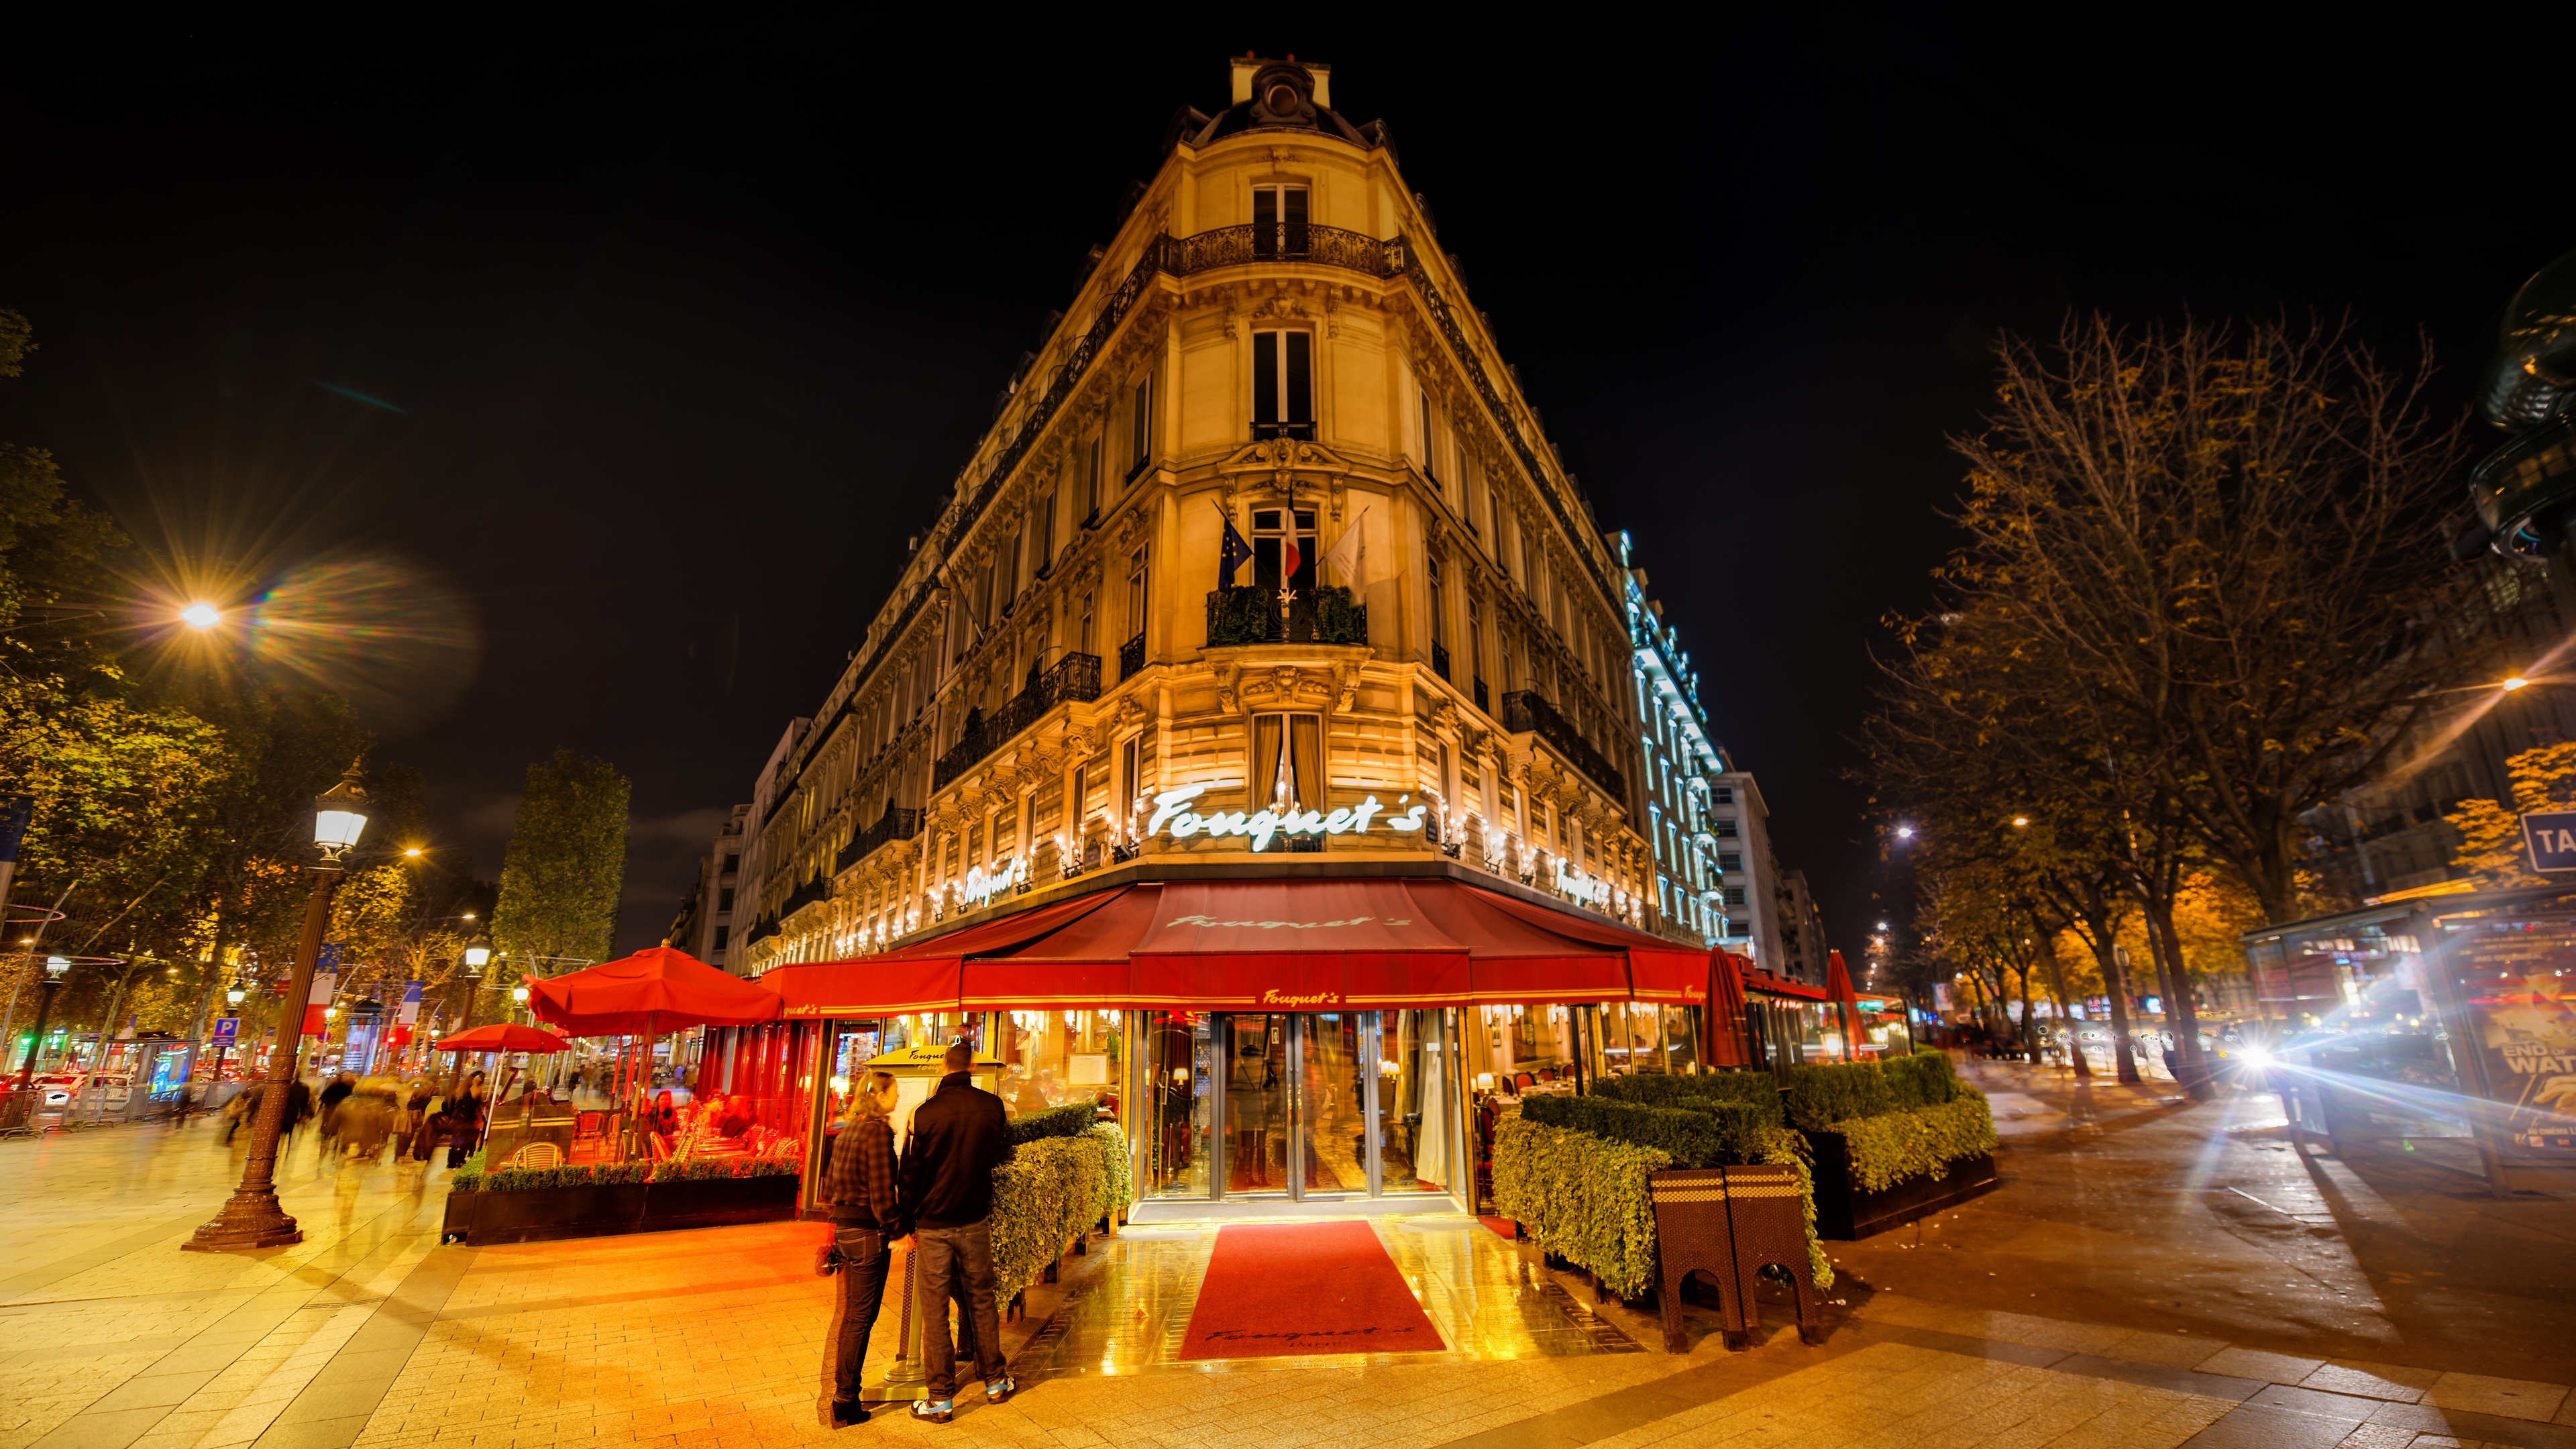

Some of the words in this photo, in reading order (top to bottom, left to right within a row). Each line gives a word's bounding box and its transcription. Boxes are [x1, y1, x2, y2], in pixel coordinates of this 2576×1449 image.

[1148, 786, 1428, 852] Fouquet's
[2536, 828, 2576, 854] TA
[1165, 915, 1412, 928] Fouquet's
[1263, 989, 1340, 1008] Fouquet's
[783, 1004, 818, 1018] quet's
[221, 1022, 233, 1034] P
[908, 1049, 946, 1063] Fouque
[2502, 1044, 2549, 1057] END
[2551, 1048, 2569, 1056] OF
[2506, 1056, 2576, 1074] WAT
[2569, 1126, 2576, 1135] L
[1205, 1326, 1416, 1341] Fouquet's
